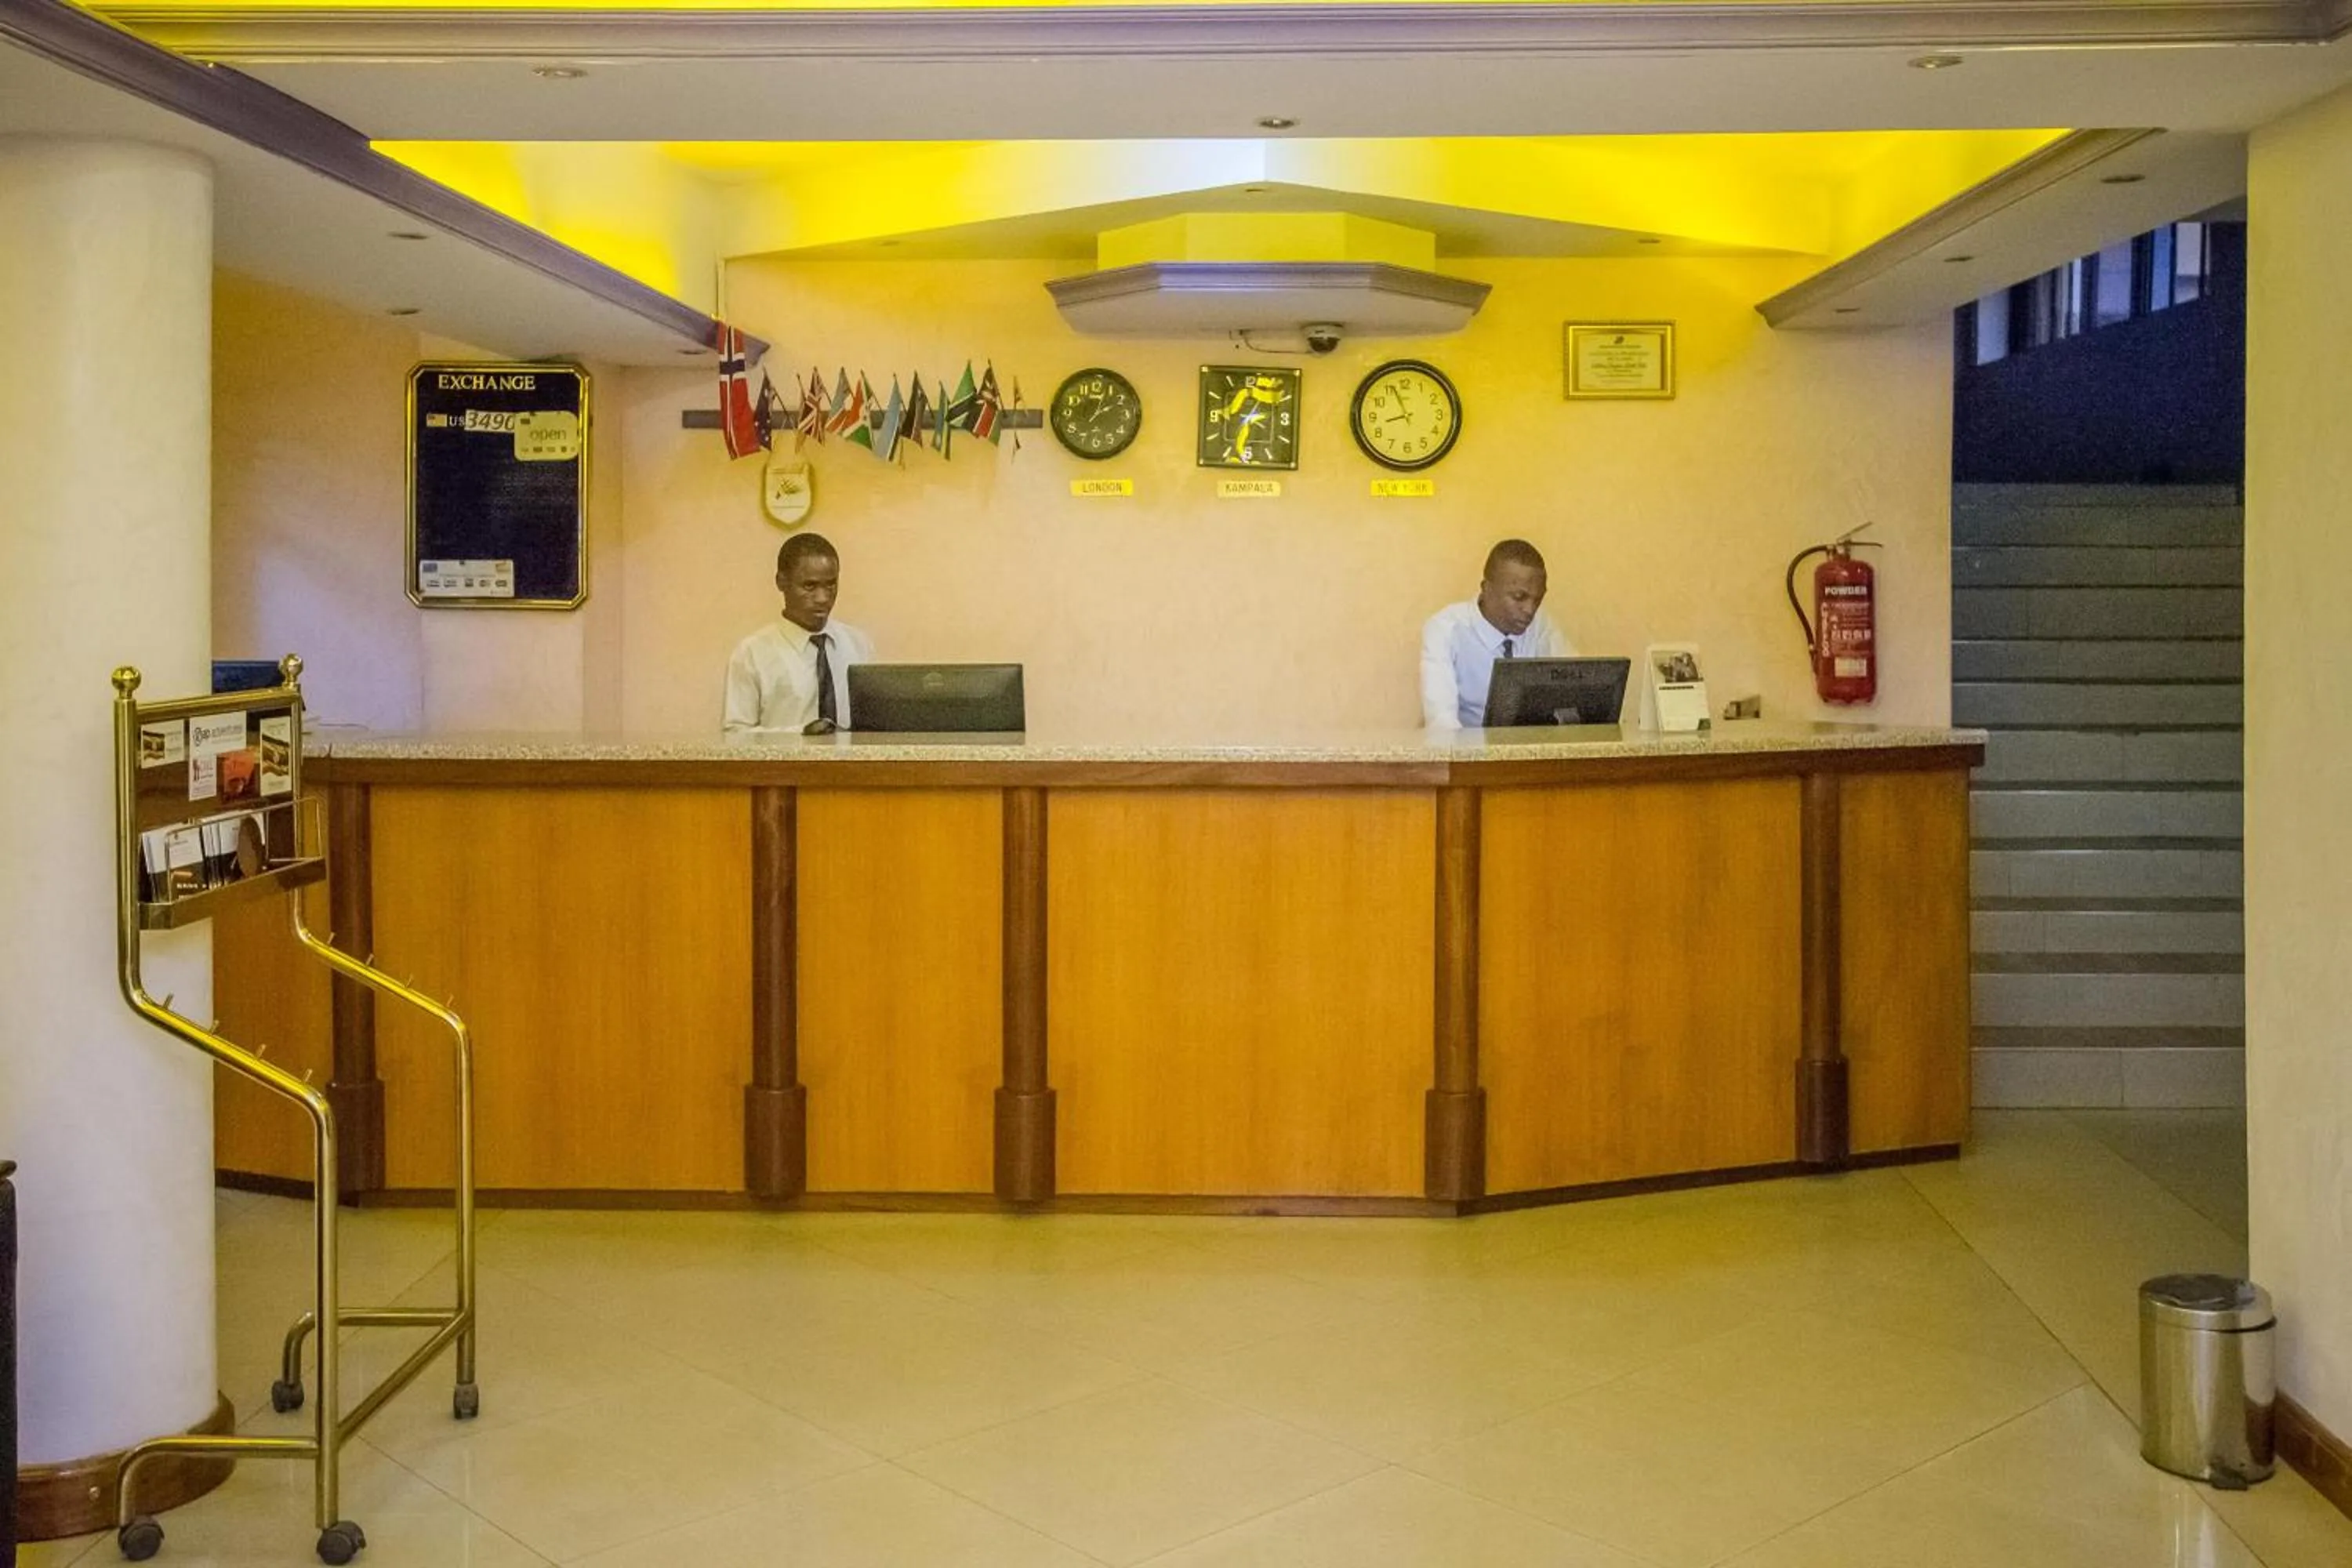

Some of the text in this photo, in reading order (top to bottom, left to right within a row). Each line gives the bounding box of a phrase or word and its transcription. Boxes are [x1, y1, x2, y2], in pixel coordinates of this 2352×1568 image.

[438, 374, 536, 390] EXCHANGE
[1399, 377, 1410, 390] 12
[1418, 383, 1423, 392] 1
[1116, 394, 1125, 405] 2
[1374, 397, 1385, 408] 10
[1430, 394, 1438, 405] 2
[1210, 409, 1218, 423] 9
[1280, 412, 1290, 426] 3
[1369, 412, 1377, 423] 9
[1436, 409, 1443, 421] 3
[1067, 423, 1076, 434] 8
[1116, 425, 1124, 434] 4
[1374, 428, 1382, 438] 8
[1431, 425, 1439, 436] 4
[530, 429, 567, 443] open
[1106, 433, 1114, 445] 5
[1092, 436, 1101, 448] 6
[1388, 439, 1396, 449] 7
[1403, 442, 1412, 453] 6
[1420, 437, 1428, 449] 5
[1082, 482, 1122, 493] LONDON
[1225, 484, 1274, 493] KAMPALA
[1377, 483, 1398, 493] NEW
[1824, 586, 1867, 595] POWDER
